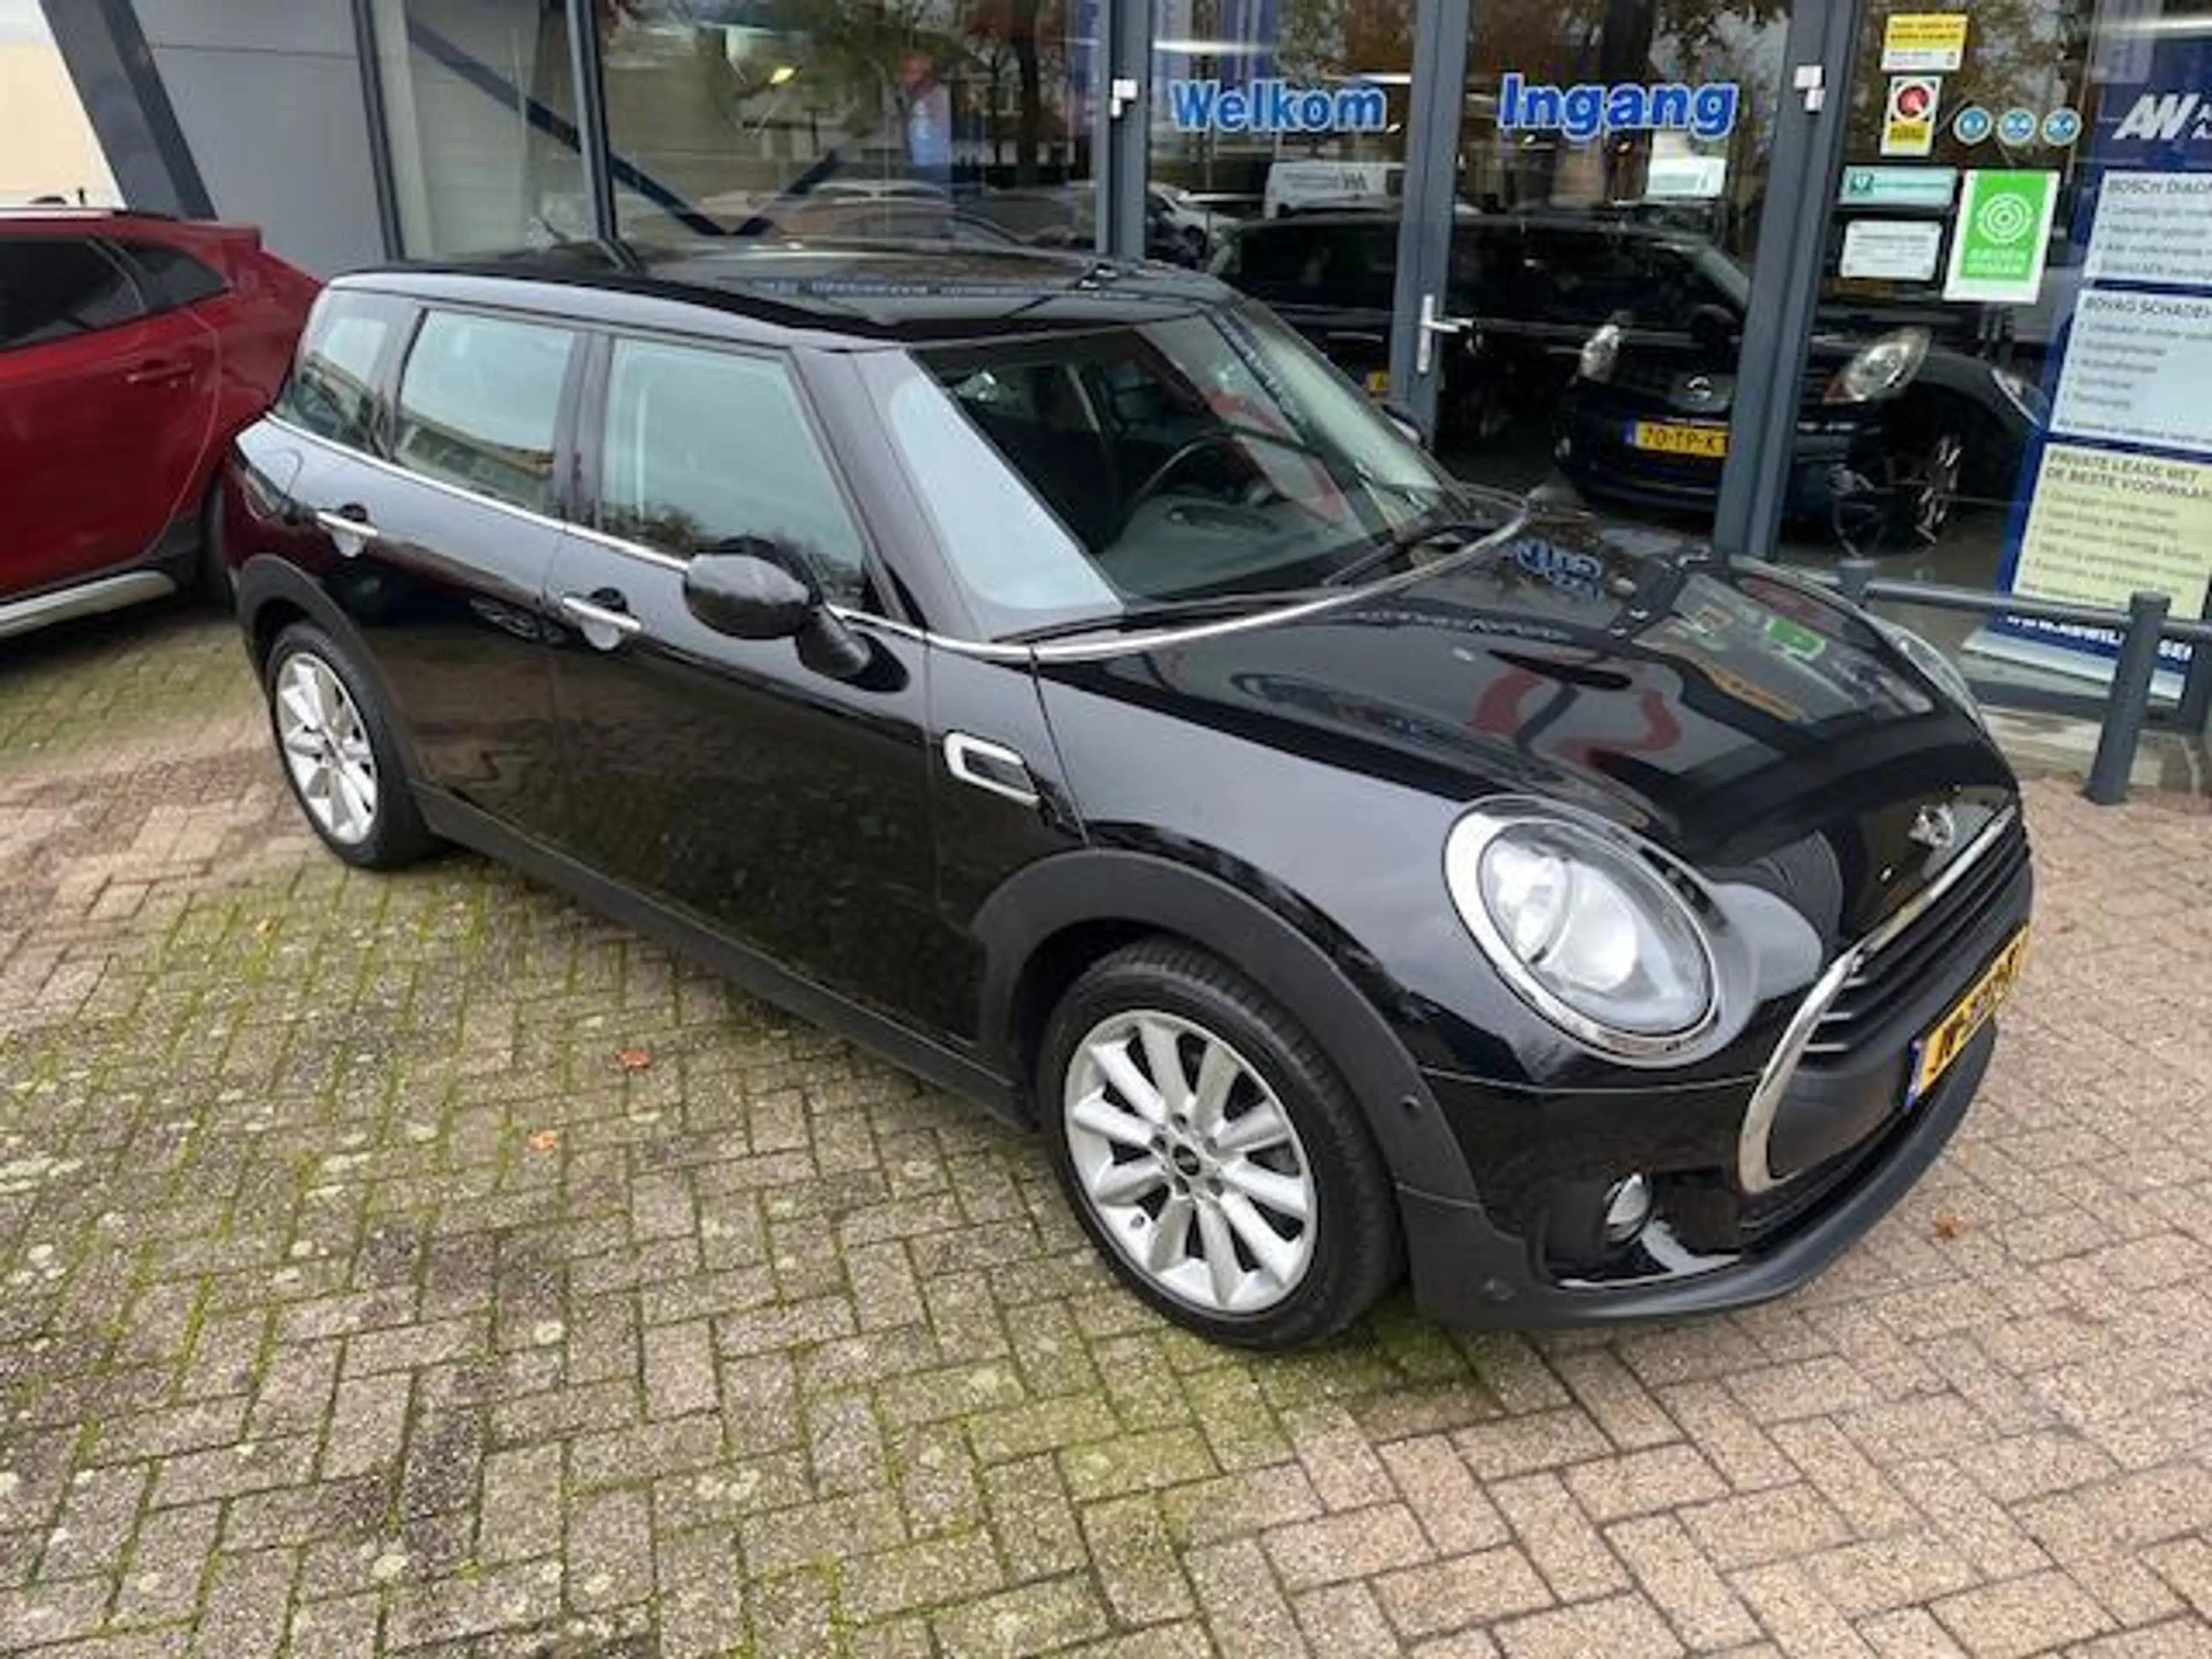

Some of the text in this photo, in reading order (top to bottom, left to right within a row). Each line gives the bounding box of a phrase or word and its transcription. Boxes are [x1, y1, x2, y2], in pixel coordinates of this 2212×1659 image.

[1169, 79, 1387, 132] Welkom
[1498, 72, 1738, 142] Ingang
[2047, 465, 2066, 478] DE
[2069, 469, 2115, 487] BESTE
[2049, 450, 2200, 482] PRIVATE LEASE MET
